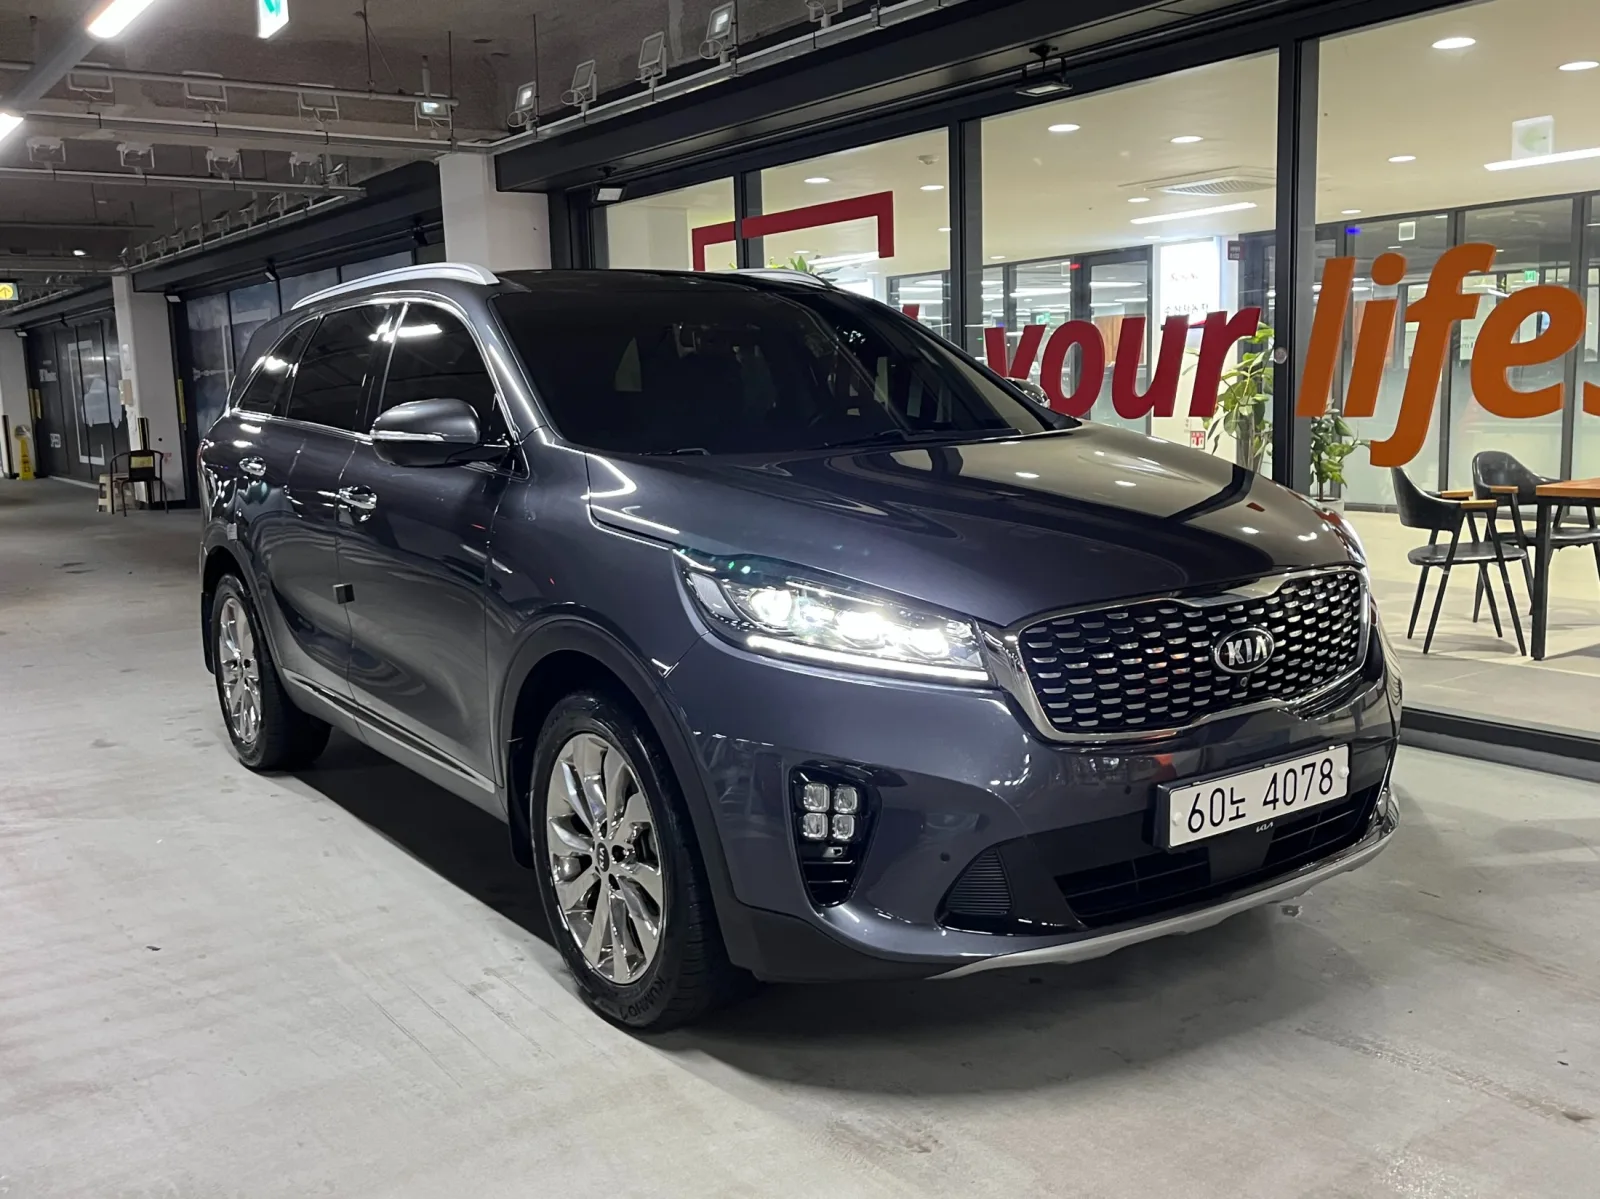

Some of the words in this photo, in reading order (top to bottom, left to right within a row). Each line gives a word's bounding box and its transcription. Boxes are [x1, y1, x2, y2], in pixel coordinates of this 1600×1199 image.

[1295, 242, 1600, 467] life
[1226, 634, 1268, 667] KIA
[1187, 786, 1247, 834] 60노
[1262, 757, 1334, 811] 4078
